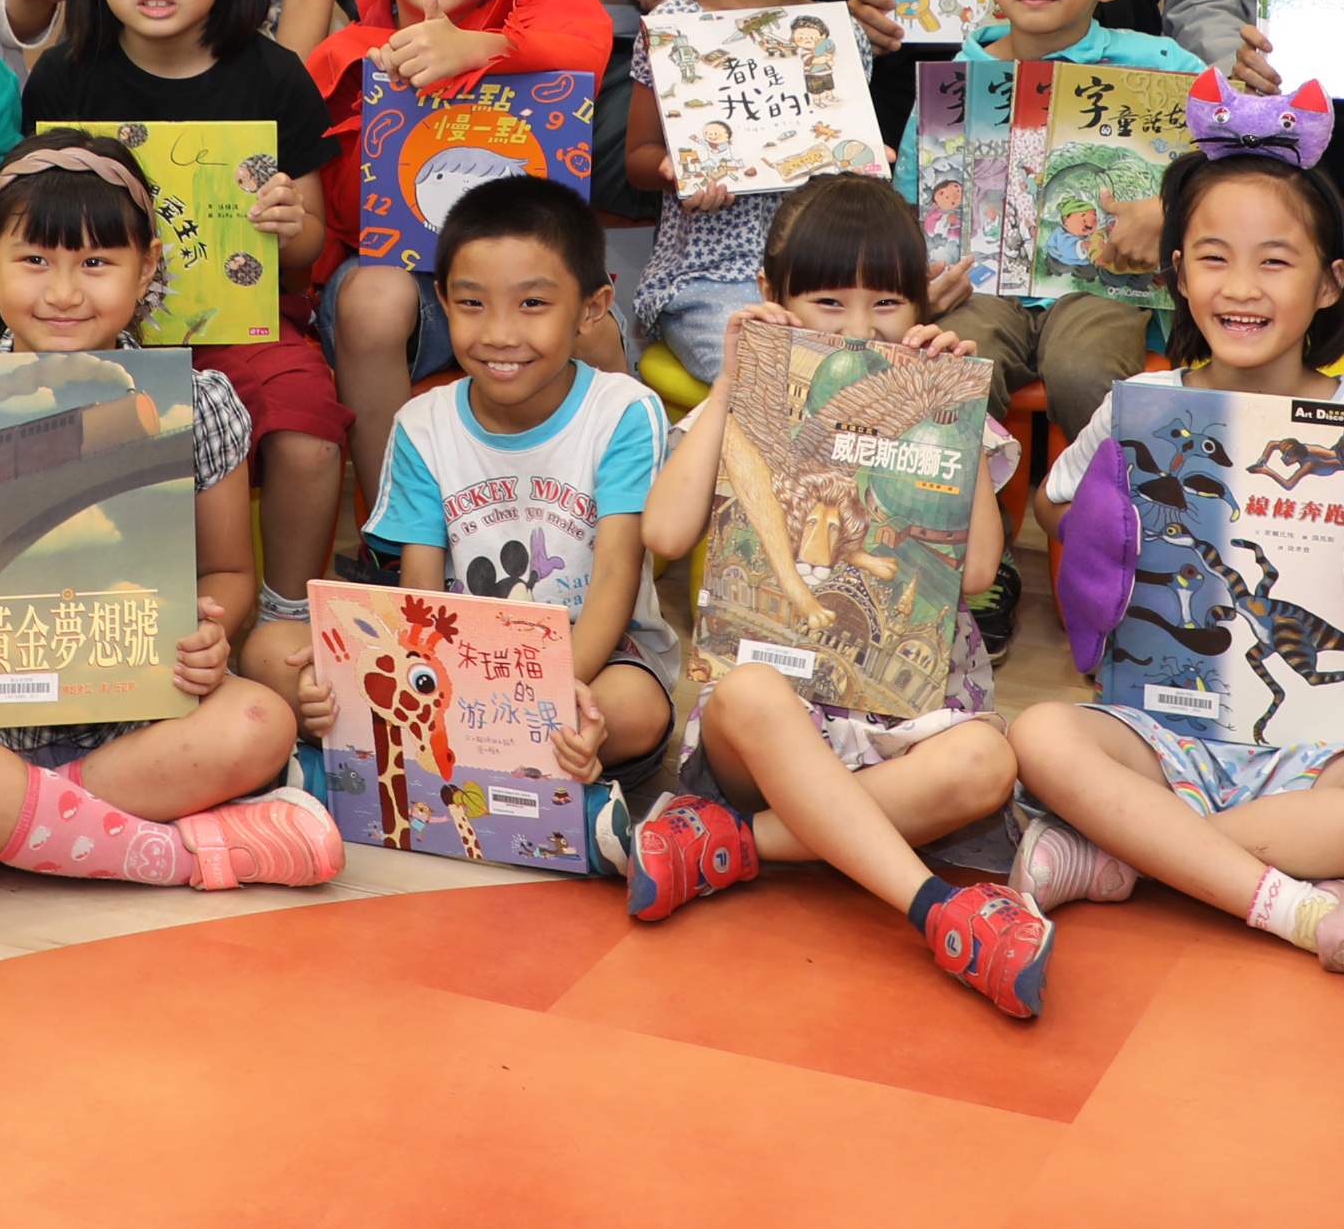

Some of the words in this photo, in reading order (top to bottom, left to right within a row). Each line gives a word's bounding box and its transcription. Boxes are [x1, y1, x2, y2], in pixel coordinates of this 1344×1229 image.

[723, 57, 785, 88] 都是
[433, 113, 532, 145] 慢一點
[1295, 407, 1313, 418] Art
[831, 432, 962, 480] 威尼斯的獅子
[482, 508, 520, 527] what
[547, 512, 585, 541] make
[458, 639, 543, 681] 朱瑞福
[514, 680, 535, 702] 的
[458, 692, 563, 743] 游泳課
